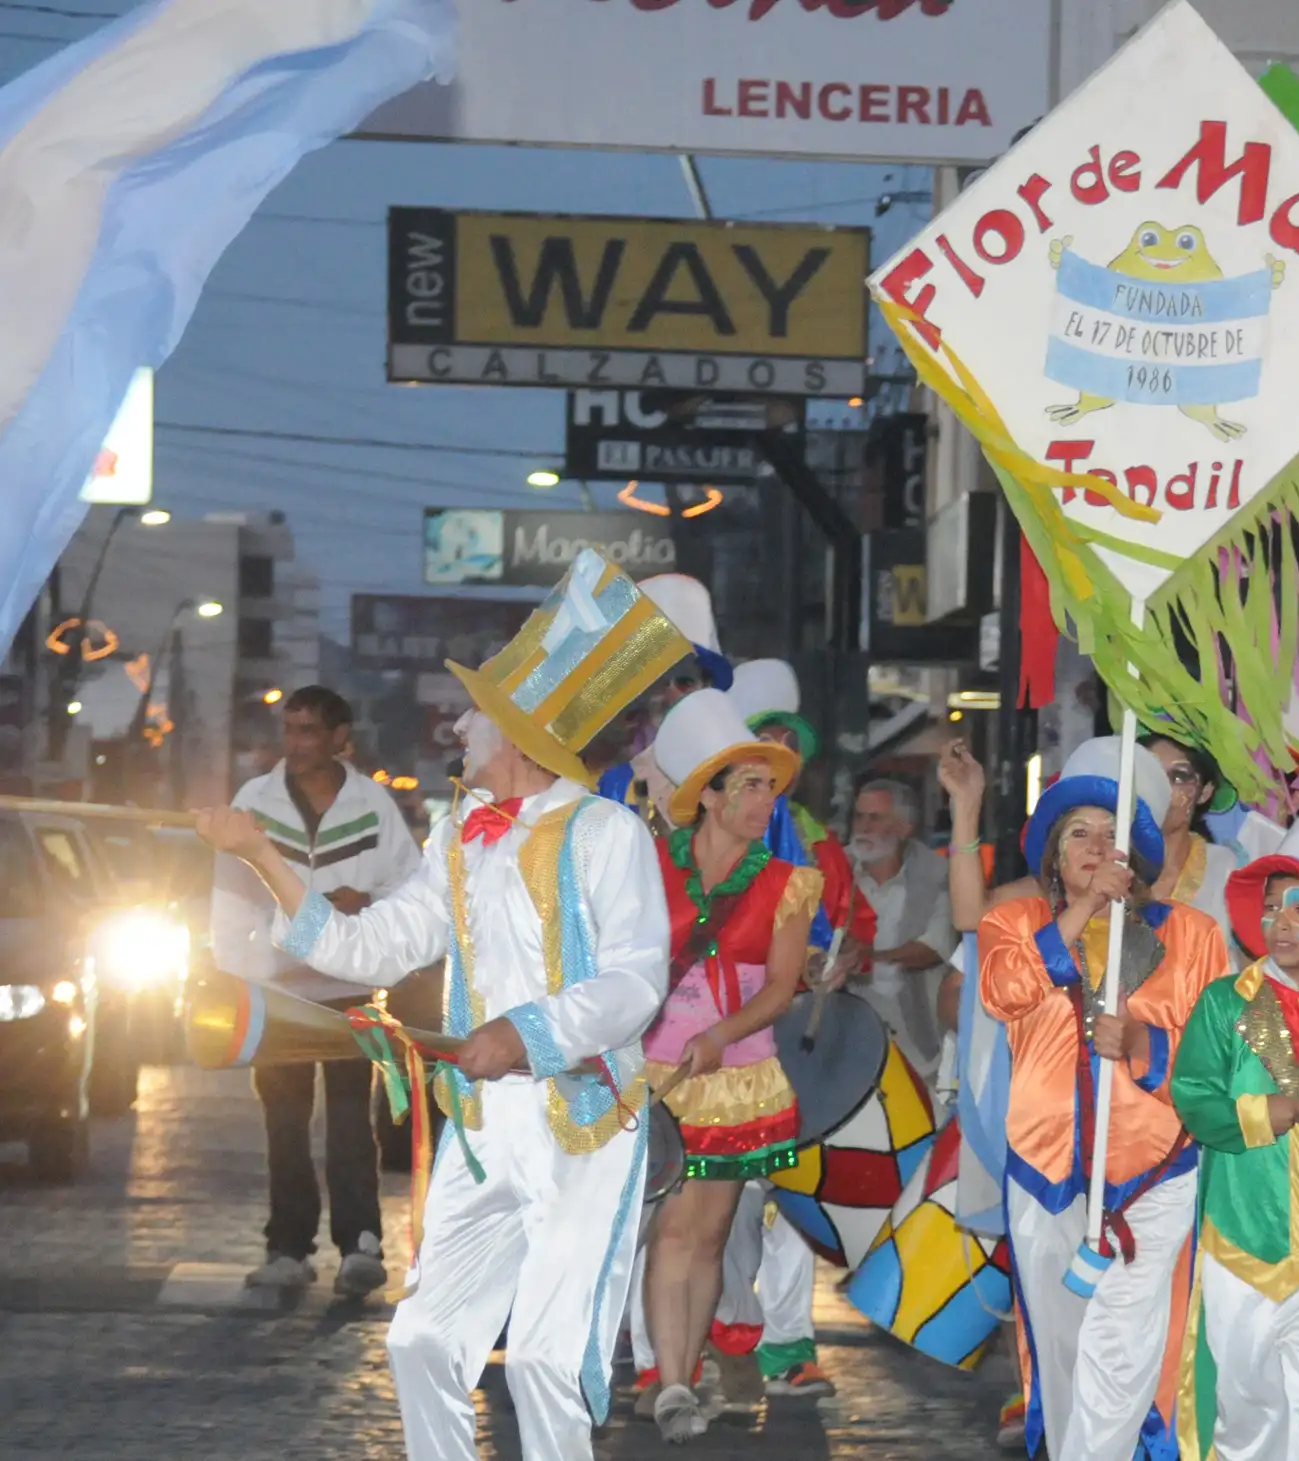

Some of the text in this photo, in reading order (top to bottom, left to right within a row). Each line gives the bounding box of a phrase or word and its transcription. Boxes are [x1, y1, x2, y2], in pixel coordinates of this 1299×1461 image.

[701, 77, 993, 127] LENCERIA
[879, 173, 1054, 352] Flor
[1070, 144, 1142, 205] de
[406, 231, 832, 337] new WAY
[1114, 284, 1203, 316] FUNDADA
[1091, 319, 1112, 345] 17
[1115, 324, 1137, 353] DE
[1142, 329, 1218, 358] OCTUBRE
[1226, 328, 1244, 355] DE
[427, 349, 827, 390] CALZADOS
[1126, 364, 1173, 394] 1986
[1045, 439, 1244, 510] Tandil
[512, 524, 676, 568] Maolia
